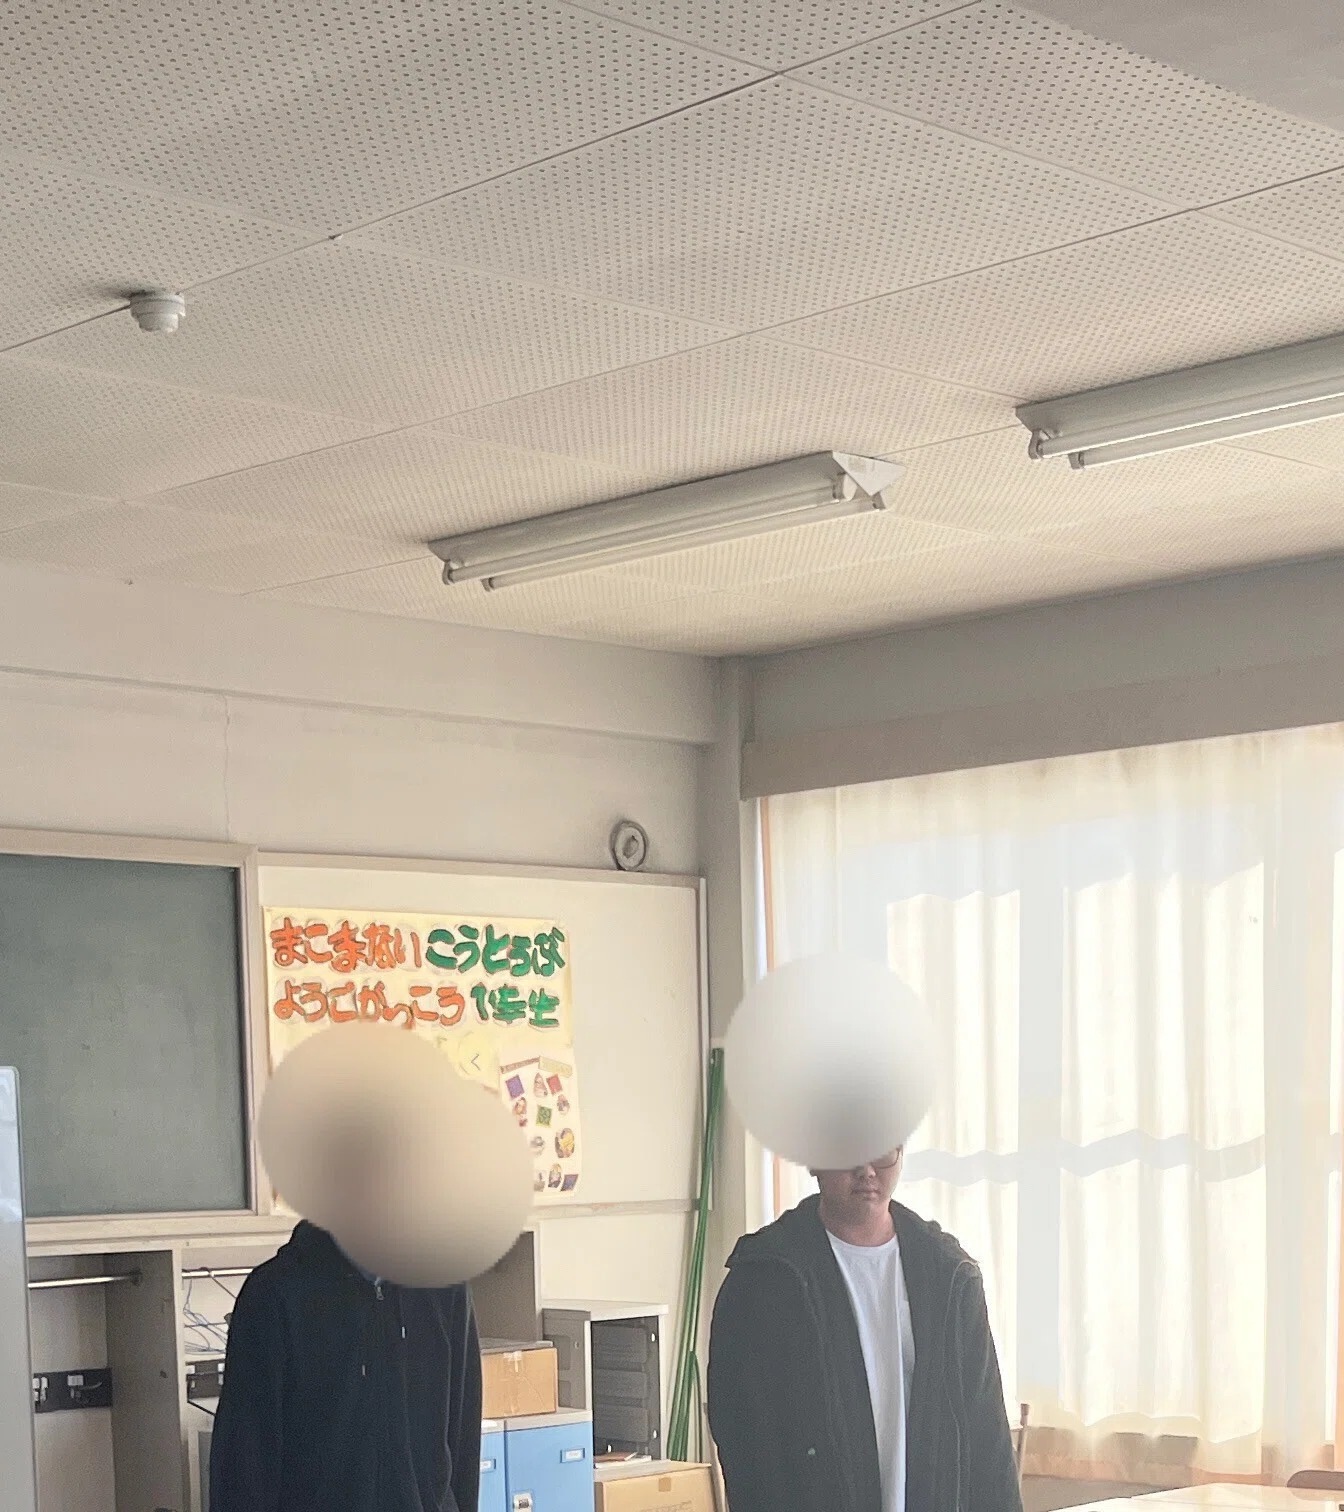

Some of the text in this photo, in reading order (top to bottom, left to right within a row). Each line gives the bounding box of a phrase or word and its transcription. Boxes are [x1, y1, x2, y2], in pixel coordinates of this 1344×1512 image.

[270, 917, 423, 973] まこまない
